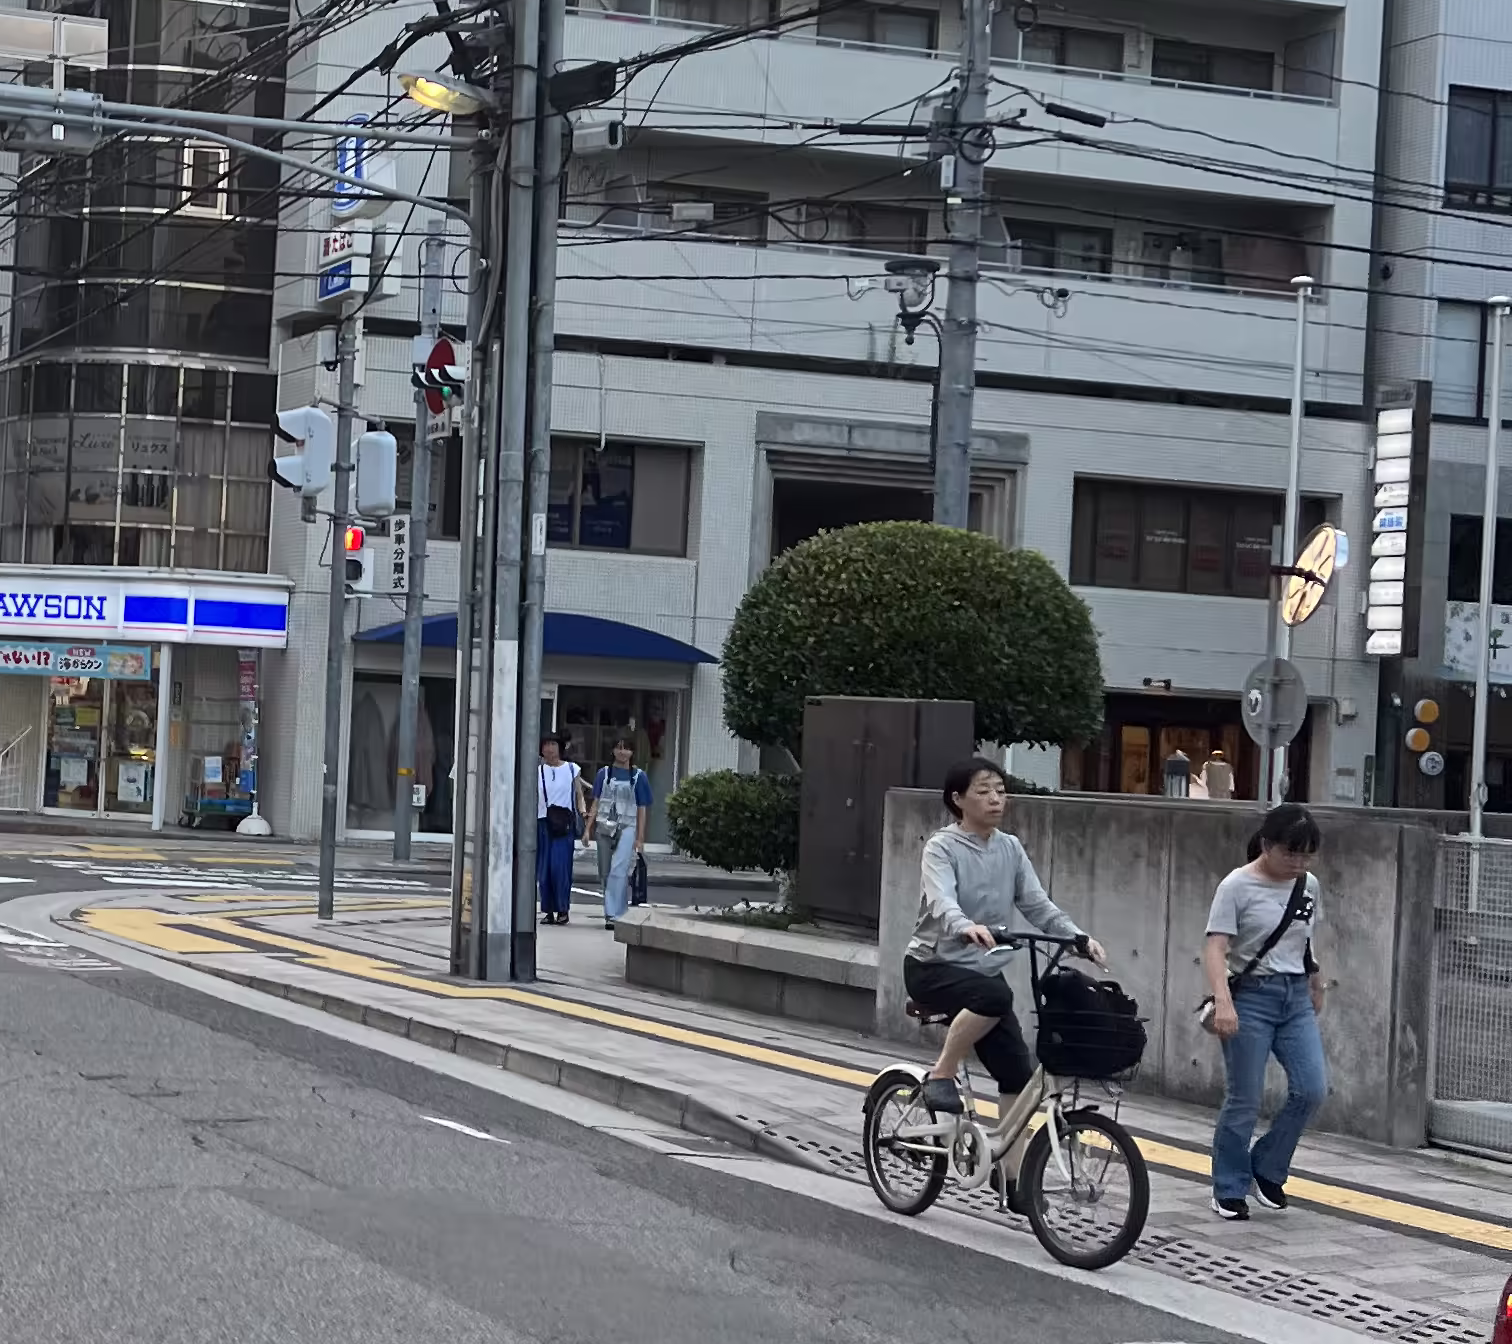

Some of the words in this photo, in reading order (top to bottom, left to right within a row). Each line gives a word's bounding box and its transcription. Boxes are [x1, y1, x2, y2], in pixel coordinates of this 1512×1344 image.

[392, 519, 406, 589] 歩車分離式
[58, 657, 103, 671] 海からクン
